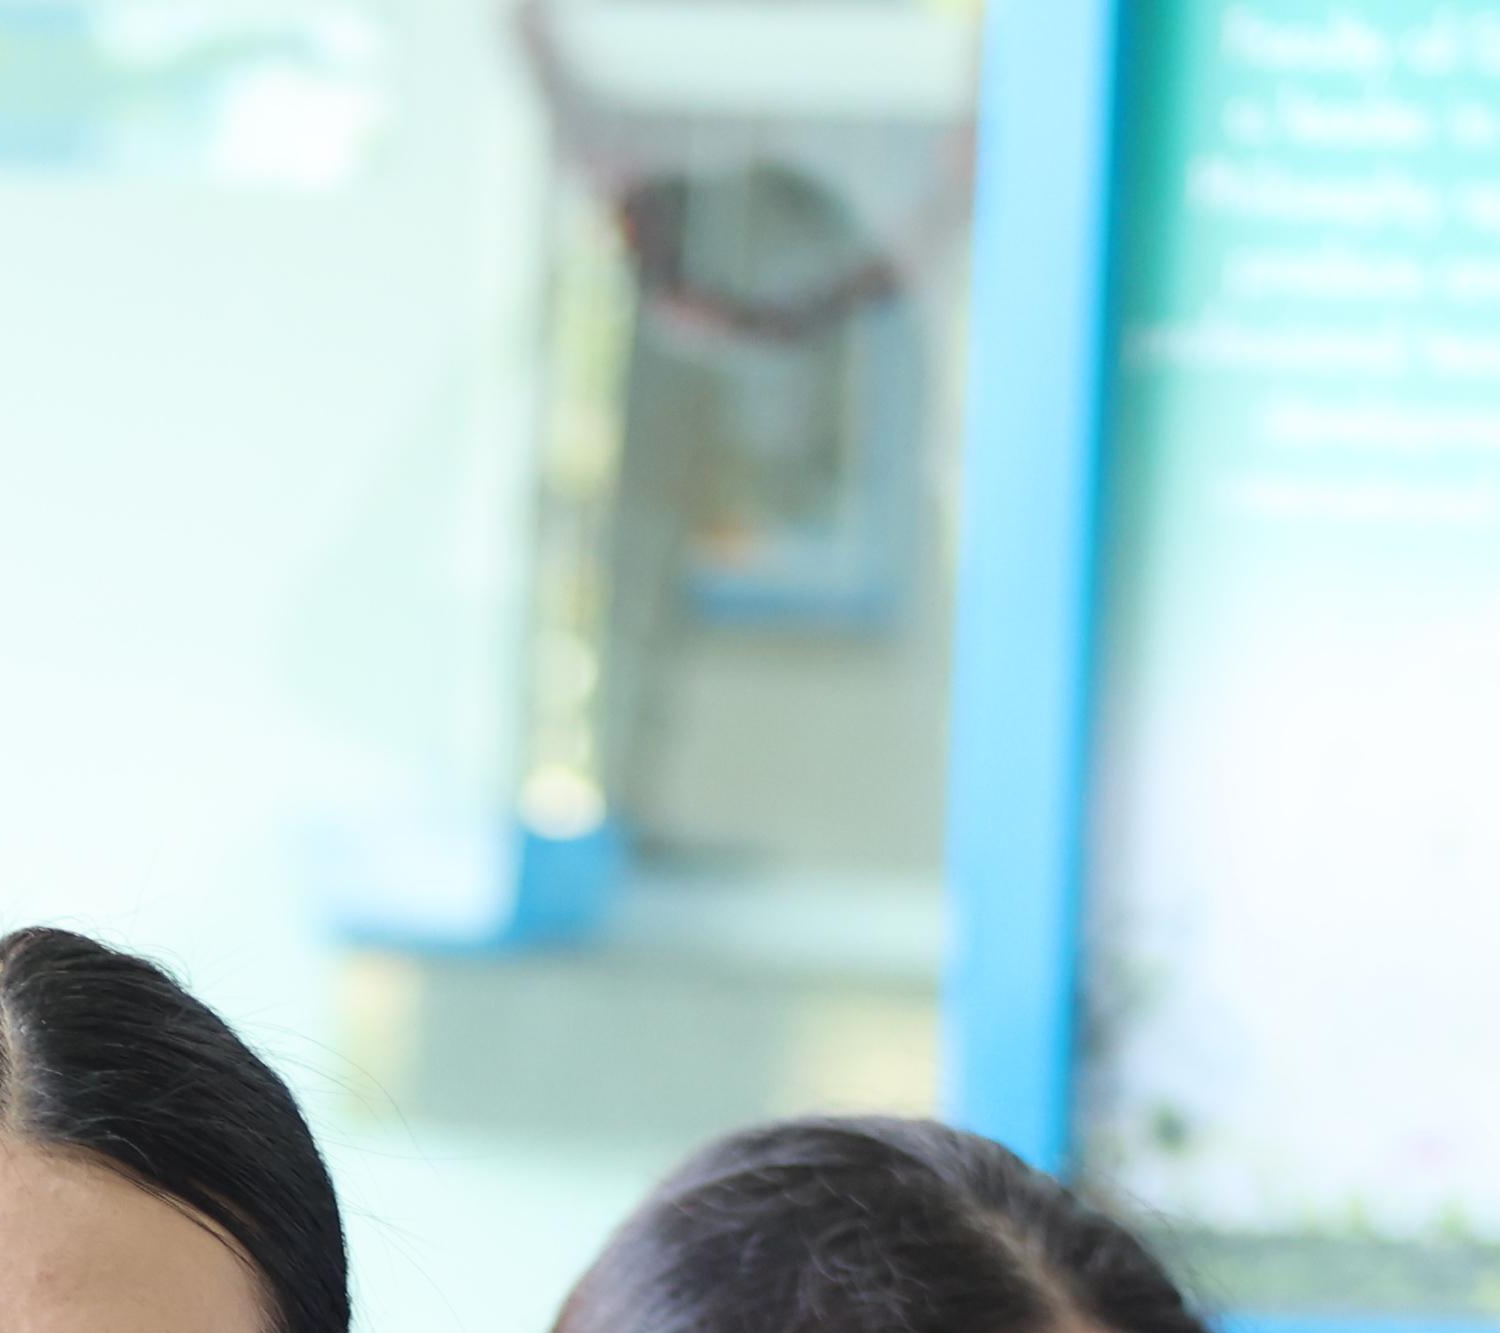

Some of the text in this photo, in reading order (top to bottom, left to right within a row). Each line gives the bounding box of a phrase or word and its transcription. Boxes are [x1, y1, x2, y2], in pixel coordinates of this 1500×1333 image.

[1225, 11, 1386, 80] Faculty
[1407, 13, 1458, 67] of
[1280, 84, 1430, 144] leader
